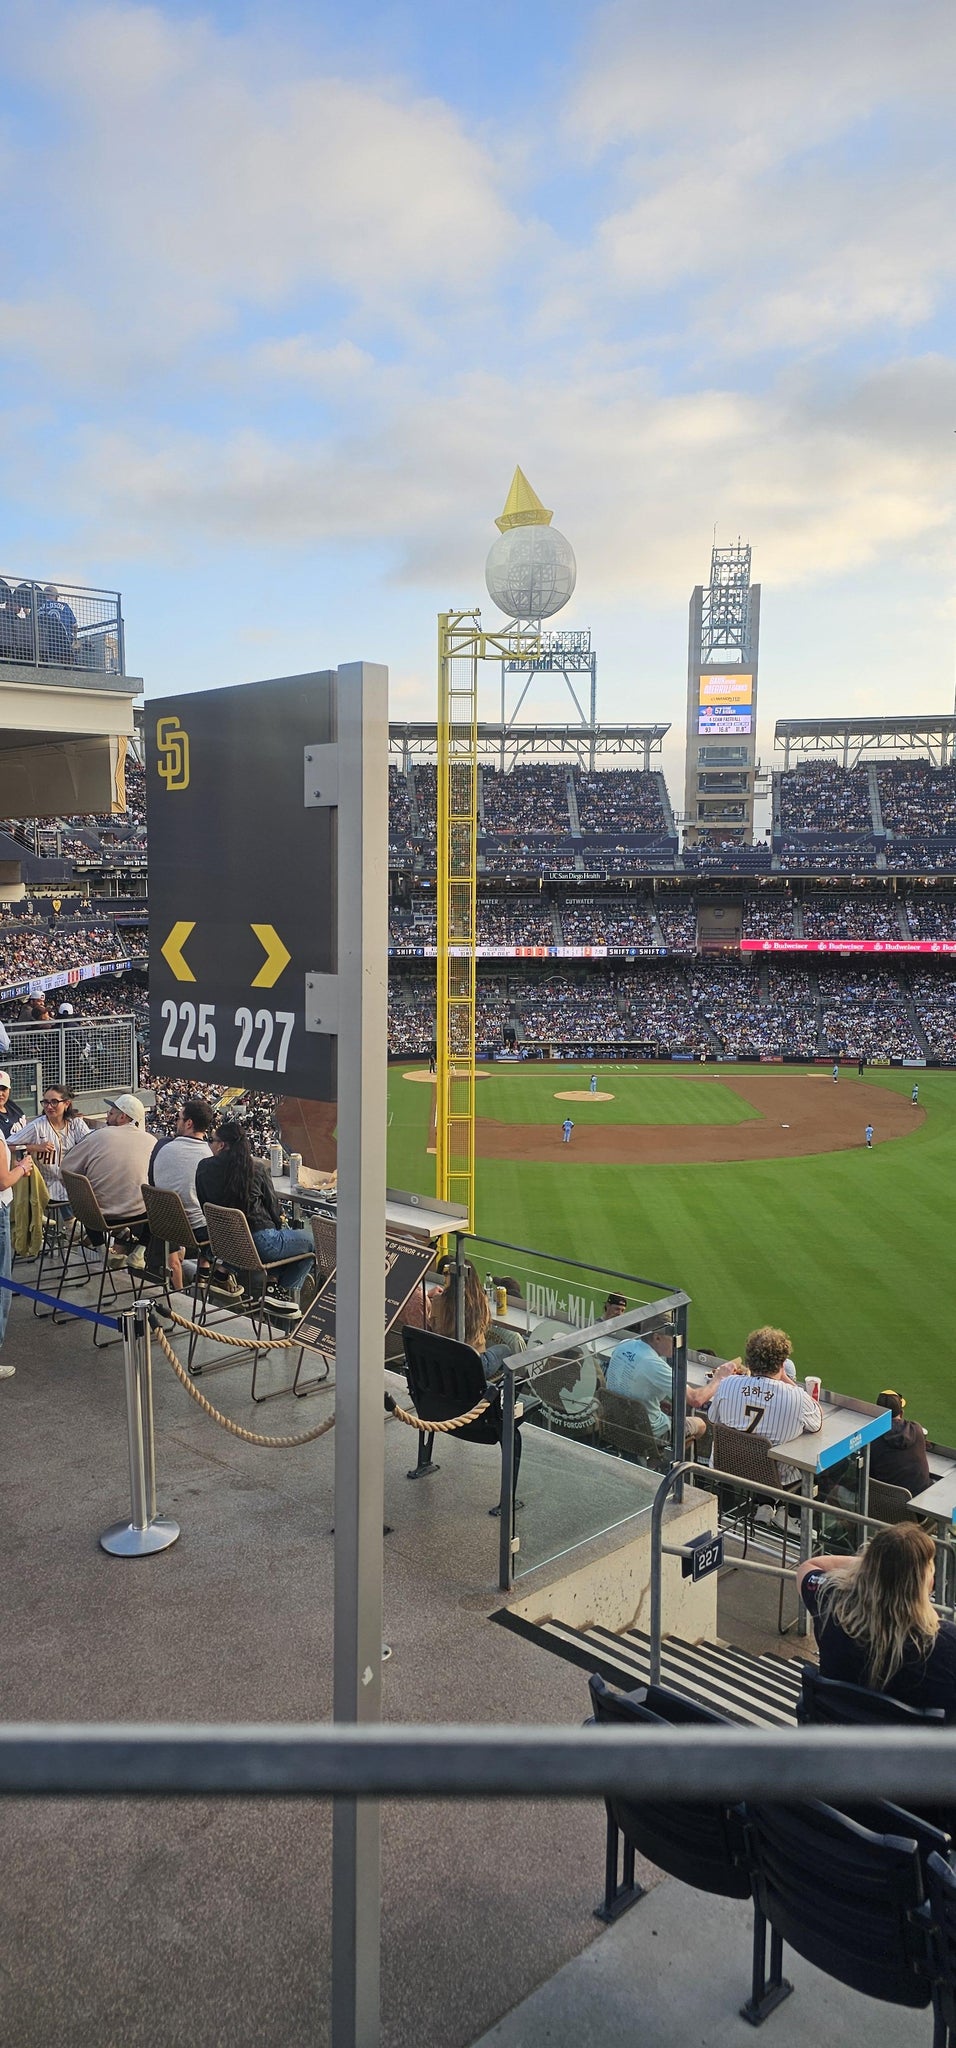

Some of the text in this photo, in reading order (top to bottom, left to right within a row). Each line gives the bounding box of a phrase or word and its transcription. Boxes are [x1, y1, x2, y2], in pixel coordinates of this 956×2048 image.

[569, 872, 584, 880] Diego
[584, 872, 600, 880] Health
[885, 943, 920, 951] Budweiser
[1, 986, 26, 1000] SHIFT SHIFT
[161, 1000, 295, 1073] 225 227
[397, 1245, 416, 1255] HONOR
[526, 1282, 595, 1329] POW MIA
[745, 1404, 765, 1433] 7
[698, 1545, 719, 1571] 227
